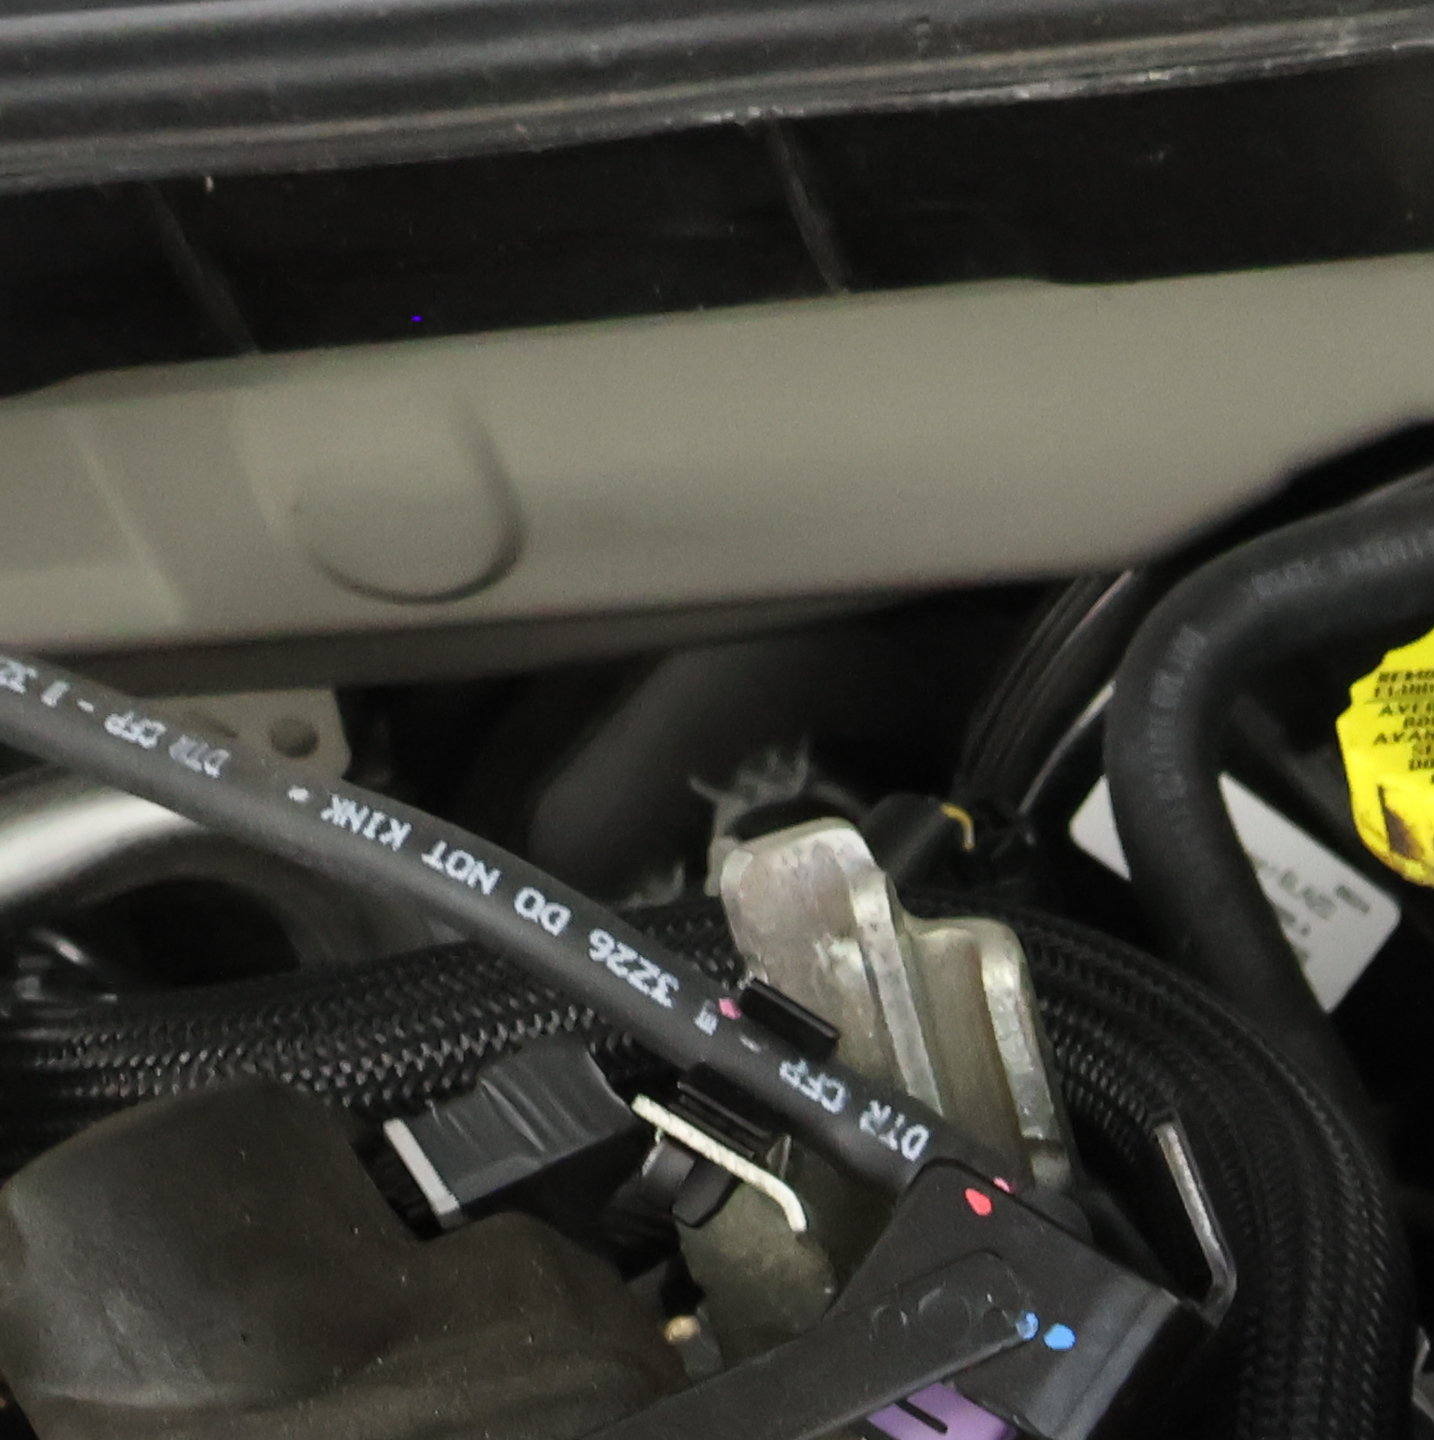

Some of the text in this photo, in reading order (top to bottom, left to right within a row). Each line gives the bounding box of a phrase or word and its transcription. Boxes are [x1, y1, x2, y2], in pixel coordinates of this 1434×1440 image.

[321, 792, 411, 850] KINK
[422, 838, 503, 897] NOT
[513, 885, 571, 936] DO
[858, 1099, 931, 1162] DTR
